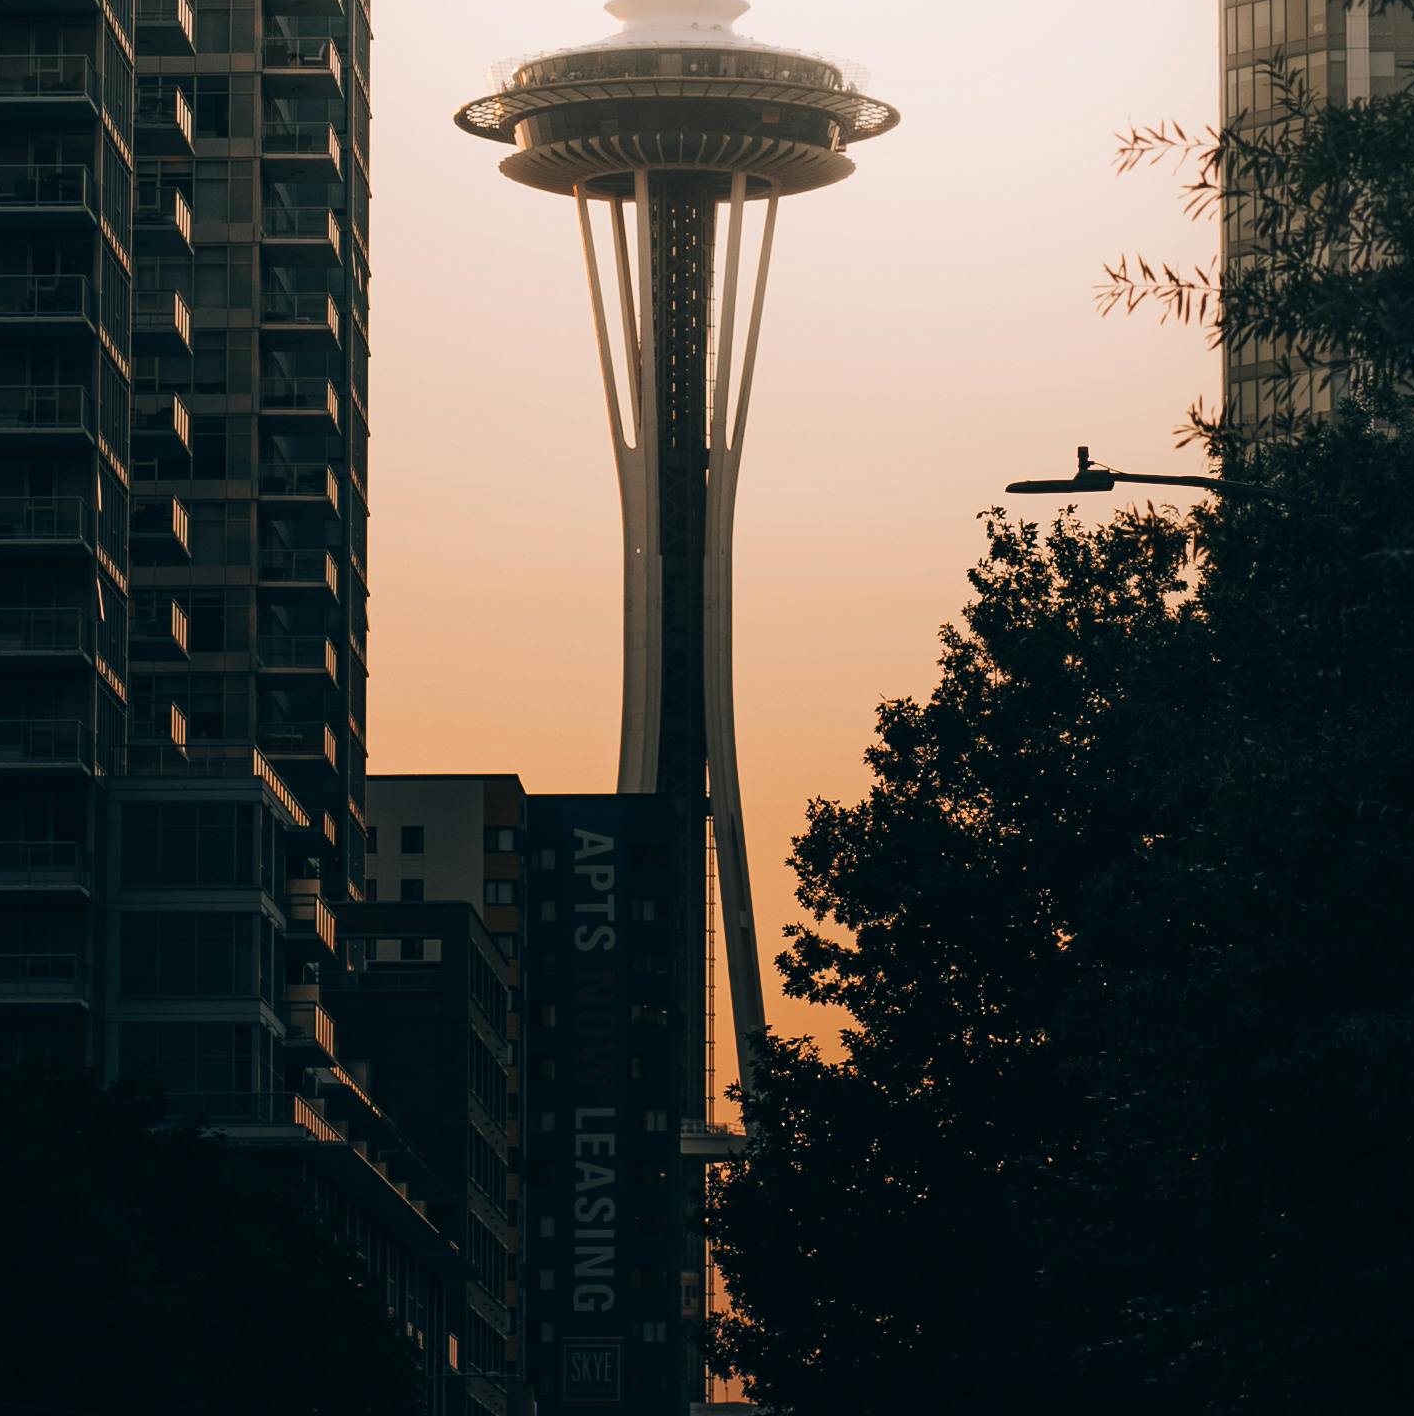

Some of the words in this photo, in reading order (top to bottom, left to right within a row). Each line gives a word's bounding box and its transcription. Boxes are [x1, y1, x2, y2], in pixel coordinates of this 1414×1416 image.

[572, 827, 616, 953] APTS
[572, 970, 617, 1091] NOW
[572, 1107, 616, 1313] LEASING
[570, 1351, 613, 1383] SKYE
